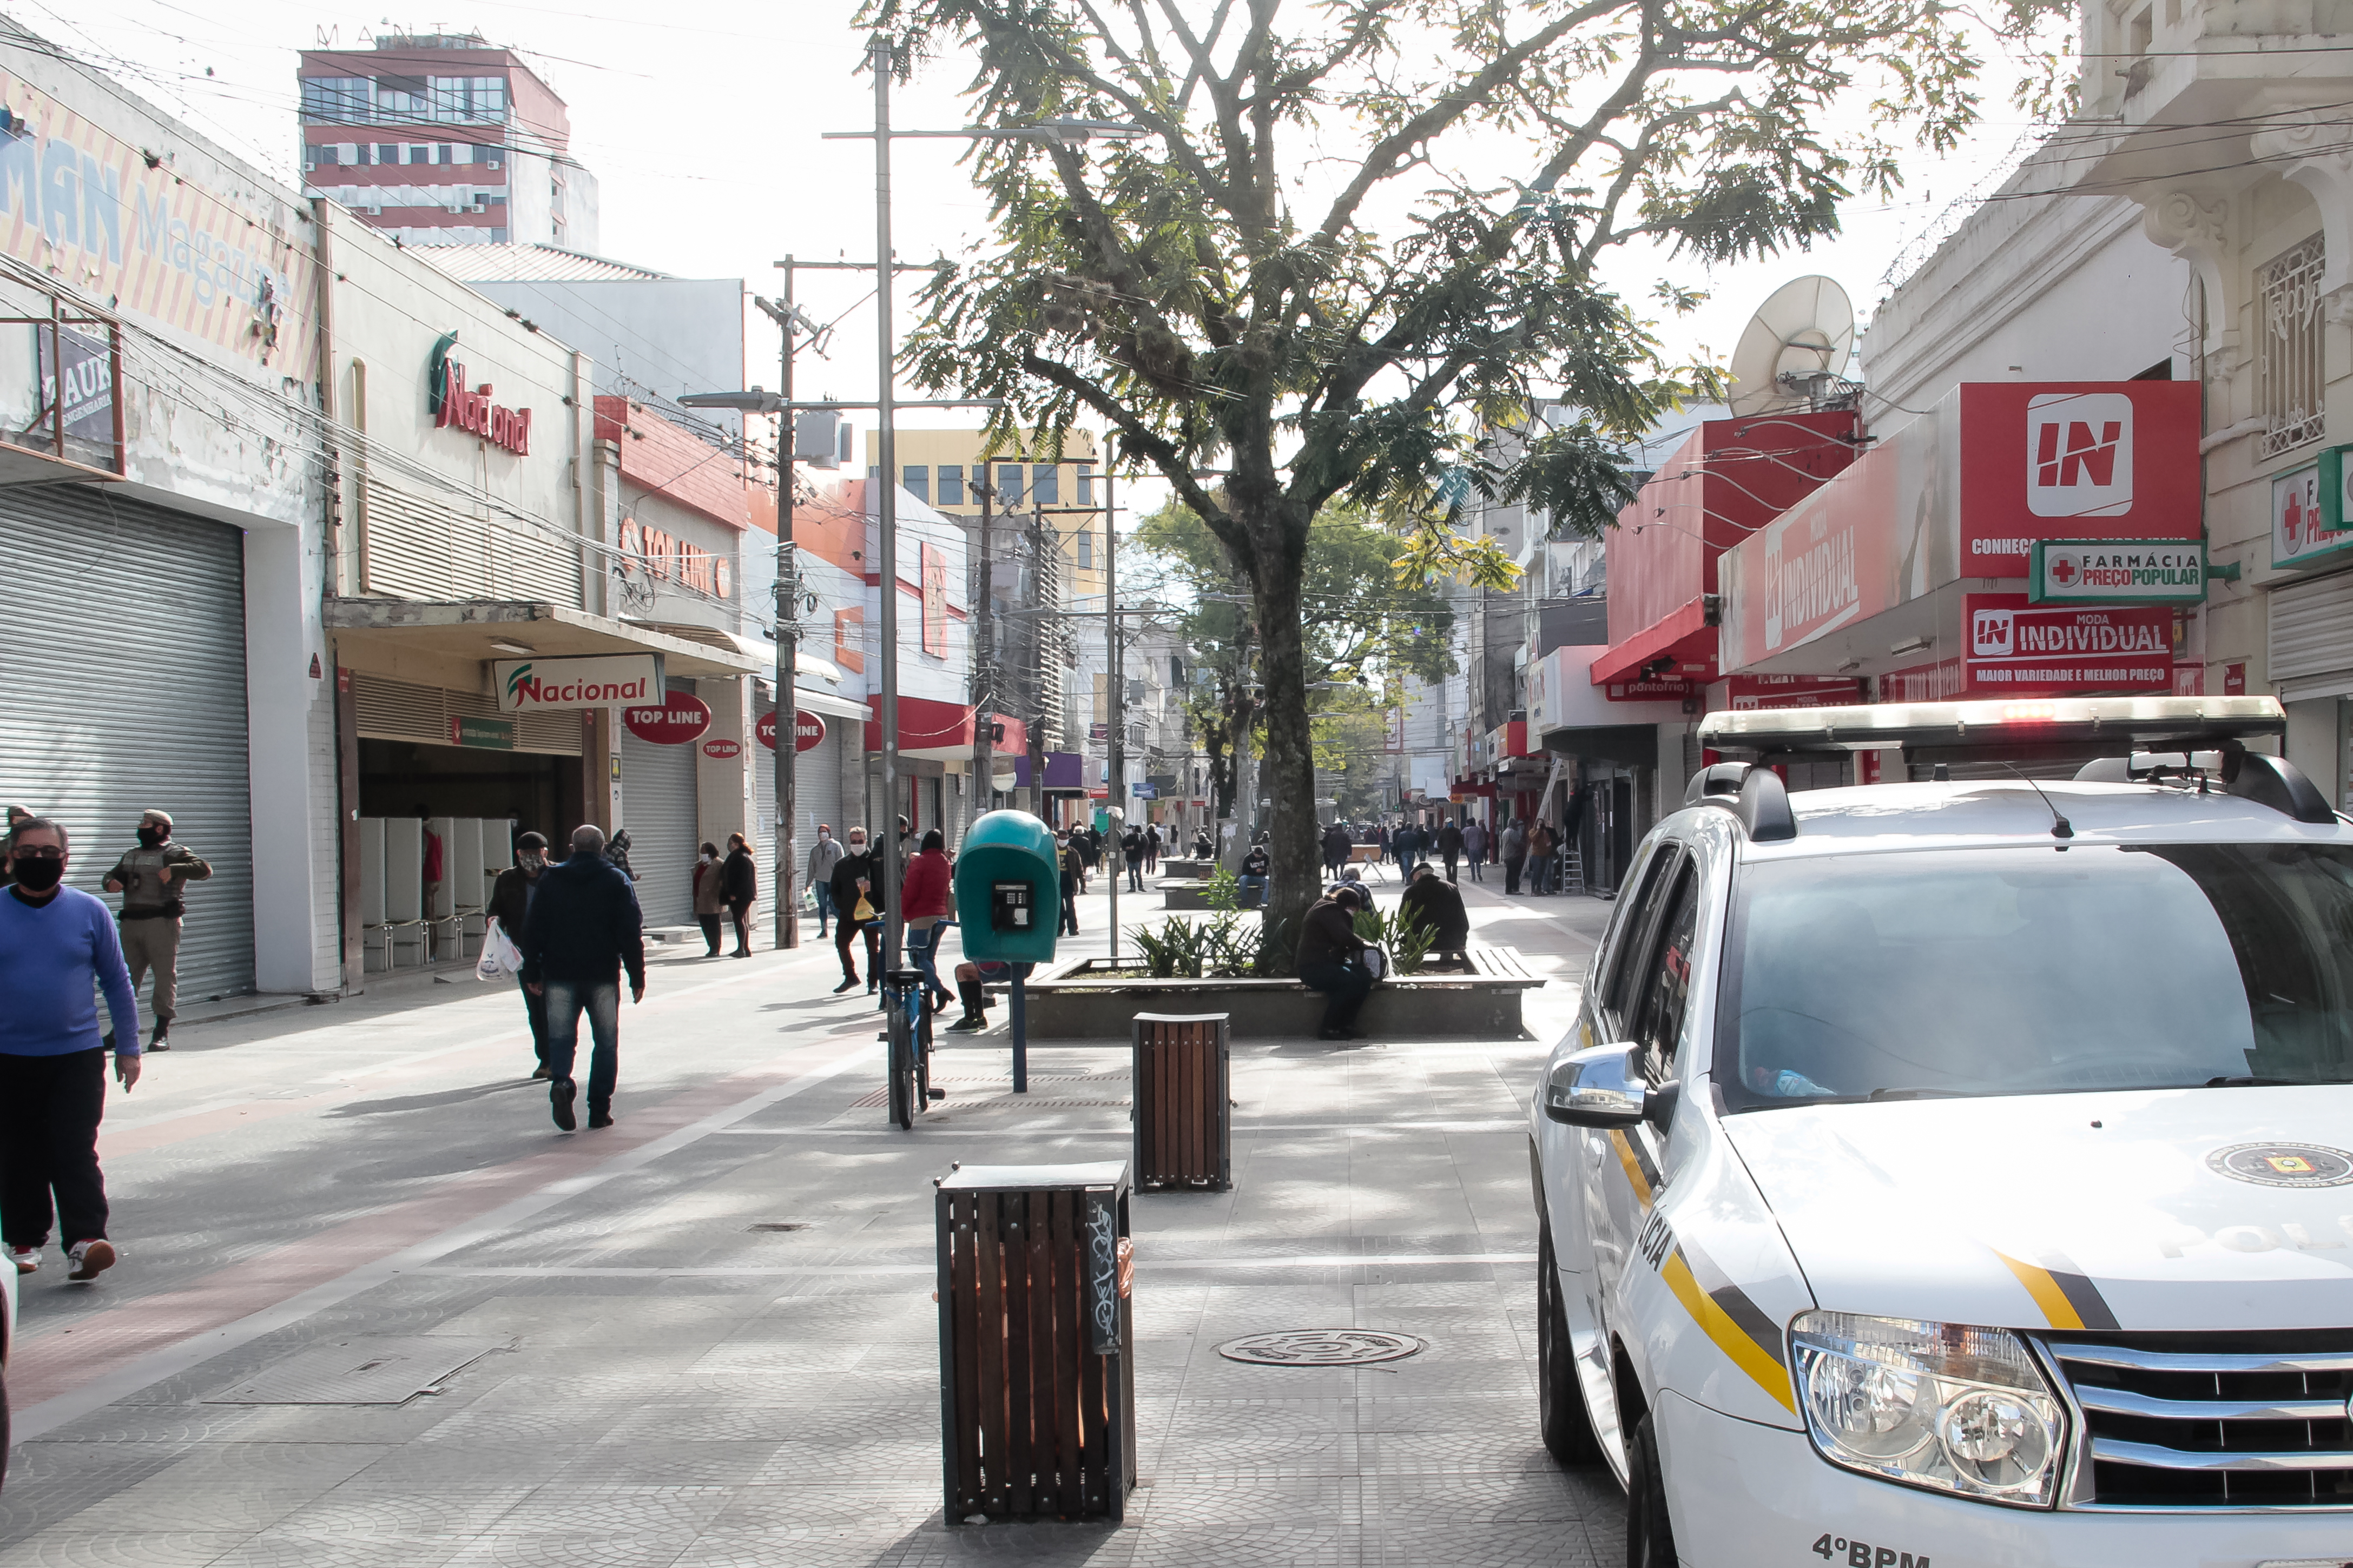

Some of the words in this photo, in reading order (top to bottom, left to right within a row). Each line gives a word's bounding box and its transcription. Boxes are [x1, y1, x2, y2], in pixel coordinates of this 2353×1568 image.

[316, 23, 489, 51] MANTA
[136, 182, 293, 323] Magazine
[436, 358, 531, 457] Nacional
[642, 525, 675, 581] TOP
[2083, 552, 2198, 567] FARMÁCIA
[1784, 525, 1858, 630] INDIVIDUAL
[2077, 614, 2110, 624] MODA
[2019, 625, 2167, 651] INDIVIDUAL
[1976, 669, 2012, 682] MAIOR
[2014, 669, 2073, 682] VARIEDADE
[2076, 669, 2081, 682] E
[2084, 669, 2127, 681] MELHOR
[2130, 668, 2165, 683] PREÇO
[513, 677, 646, 709] Nacional
[632, 710, 663, 724] TOP
[668, 711, 702, 725] LINE
[706, 745, 721, 753] TOP
[723, 745, 738, 753] LINE
